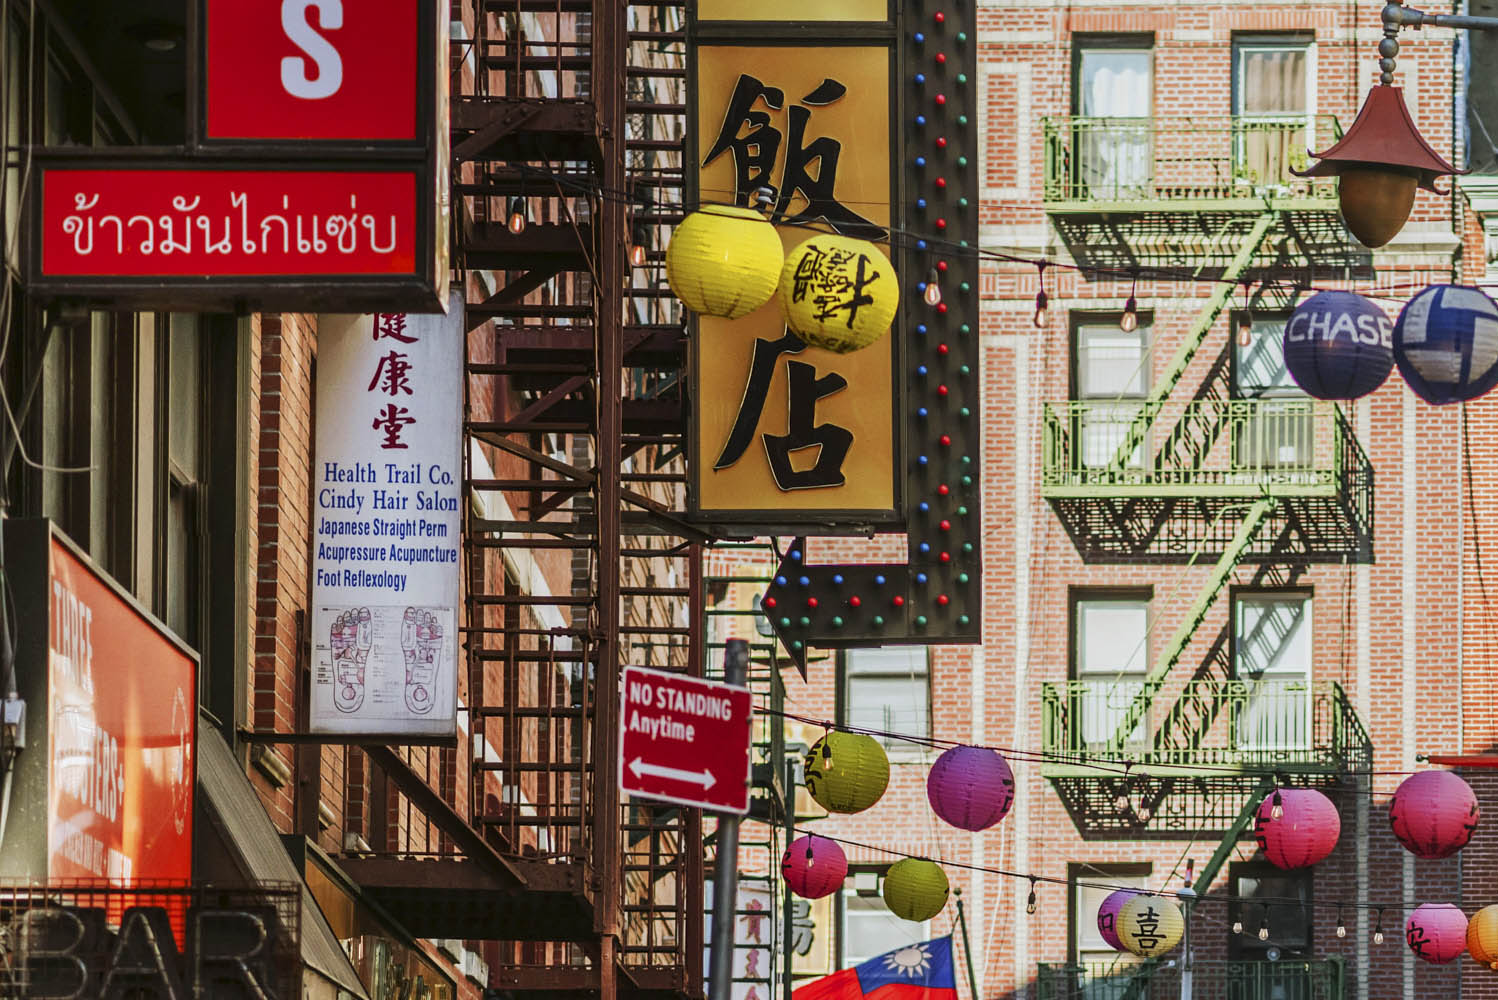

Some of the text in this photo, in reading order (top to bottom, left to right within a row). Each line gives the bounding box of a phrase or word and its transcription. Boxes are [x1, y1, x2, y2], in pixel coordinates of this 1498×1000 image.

[62, 191, 397, 256] ข้าวมันไก่แซ่บ
[701, 74, 890, 491] 飯店
[1288, 311, 1394, 348] CHASE
[365, 312, 420, 450] 健康堂
[324, 462, 454, 485] Health Trail Co.
[319, 488, 458, 515] Cindy Hair Salon
[318, 516, 448, 541] Japanese Straight Perm
[318, 542, 458, 566] Acupressure Acupuncture
[317, 568, 408, 592] Foot Reflexology
[630, 681, 732, 722] NO STANDING
[629, 709, 696, 743] Anytime
[1131, 906, 1168, 949] 喜
